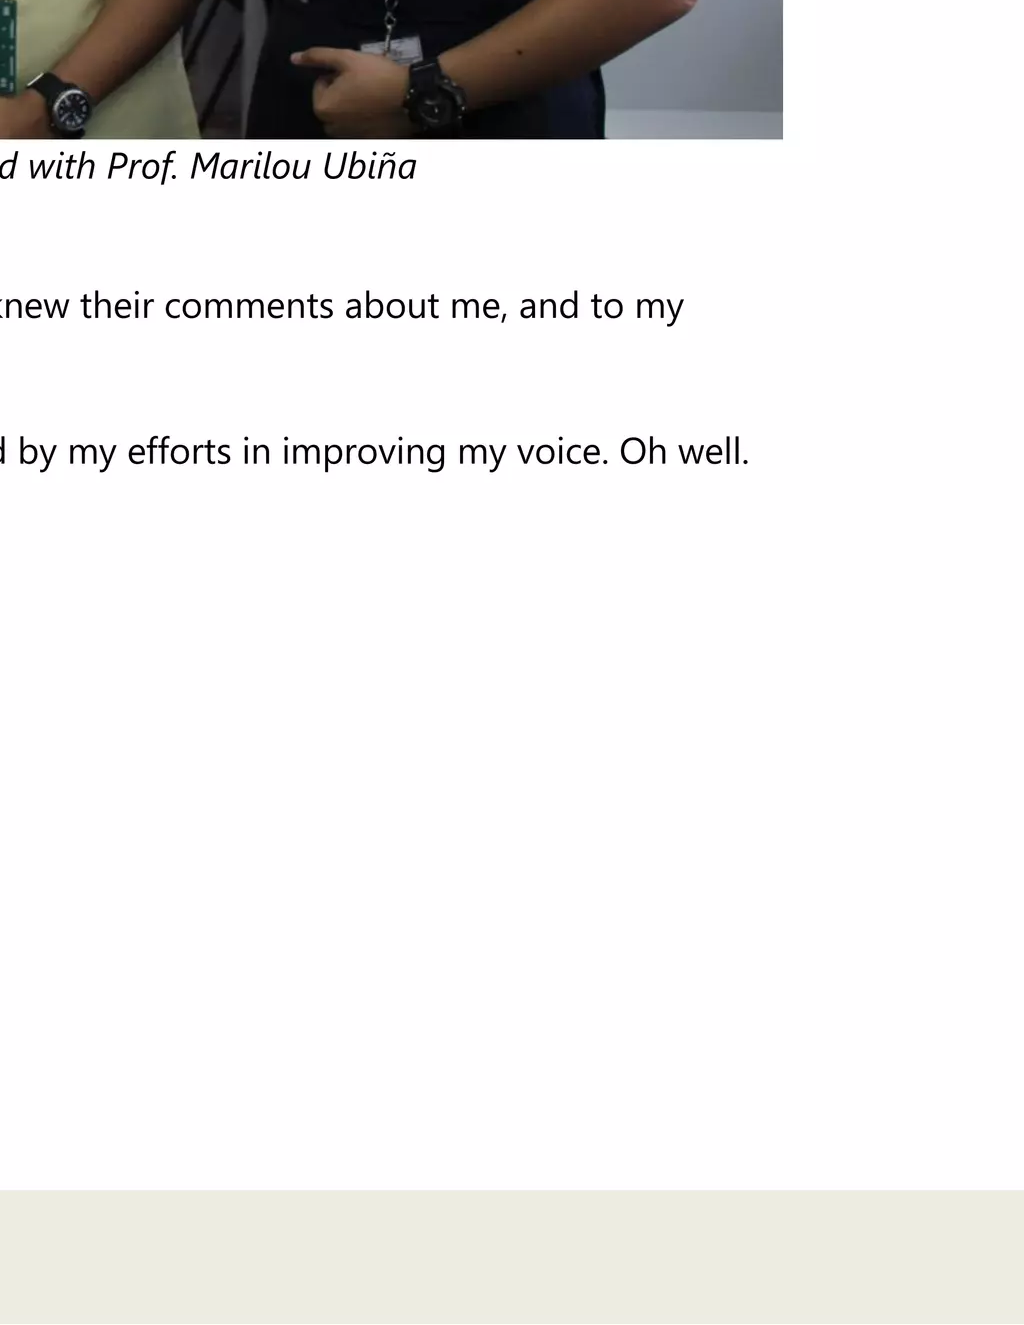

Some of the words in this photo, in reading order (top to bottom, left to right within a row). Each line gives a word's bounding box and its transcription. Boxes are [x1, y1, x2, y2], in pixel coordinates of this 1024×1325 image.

[29, 150, 96, 180] with
[107, 149, 177, 186] Prof.
[190, 150, 312, 180] Marilou
[323, 150, 417, 180] Ubiña
[79, 289, 155, 320] their
[165, 293, 334, 320] comments
[345, 289, 440, 320] about
[451, 298, 507, 324] me,
[519, 289, 579, 320] and
[590, 293, 624, 320] to
[636, 298, 685, 328] my
[19, 435, 58, 474] by
[69, 443, 118, 474] my
[128, 435, 232, 465] efforts
[243, 435, 270, 465] in
[283, 435, 445, 474] improving
[459, 443, 508, 474] my
[516, 435, 608, 465] voice.
[620, 435, 667, 465] Oh
[677, 435, 749, 465] well.
